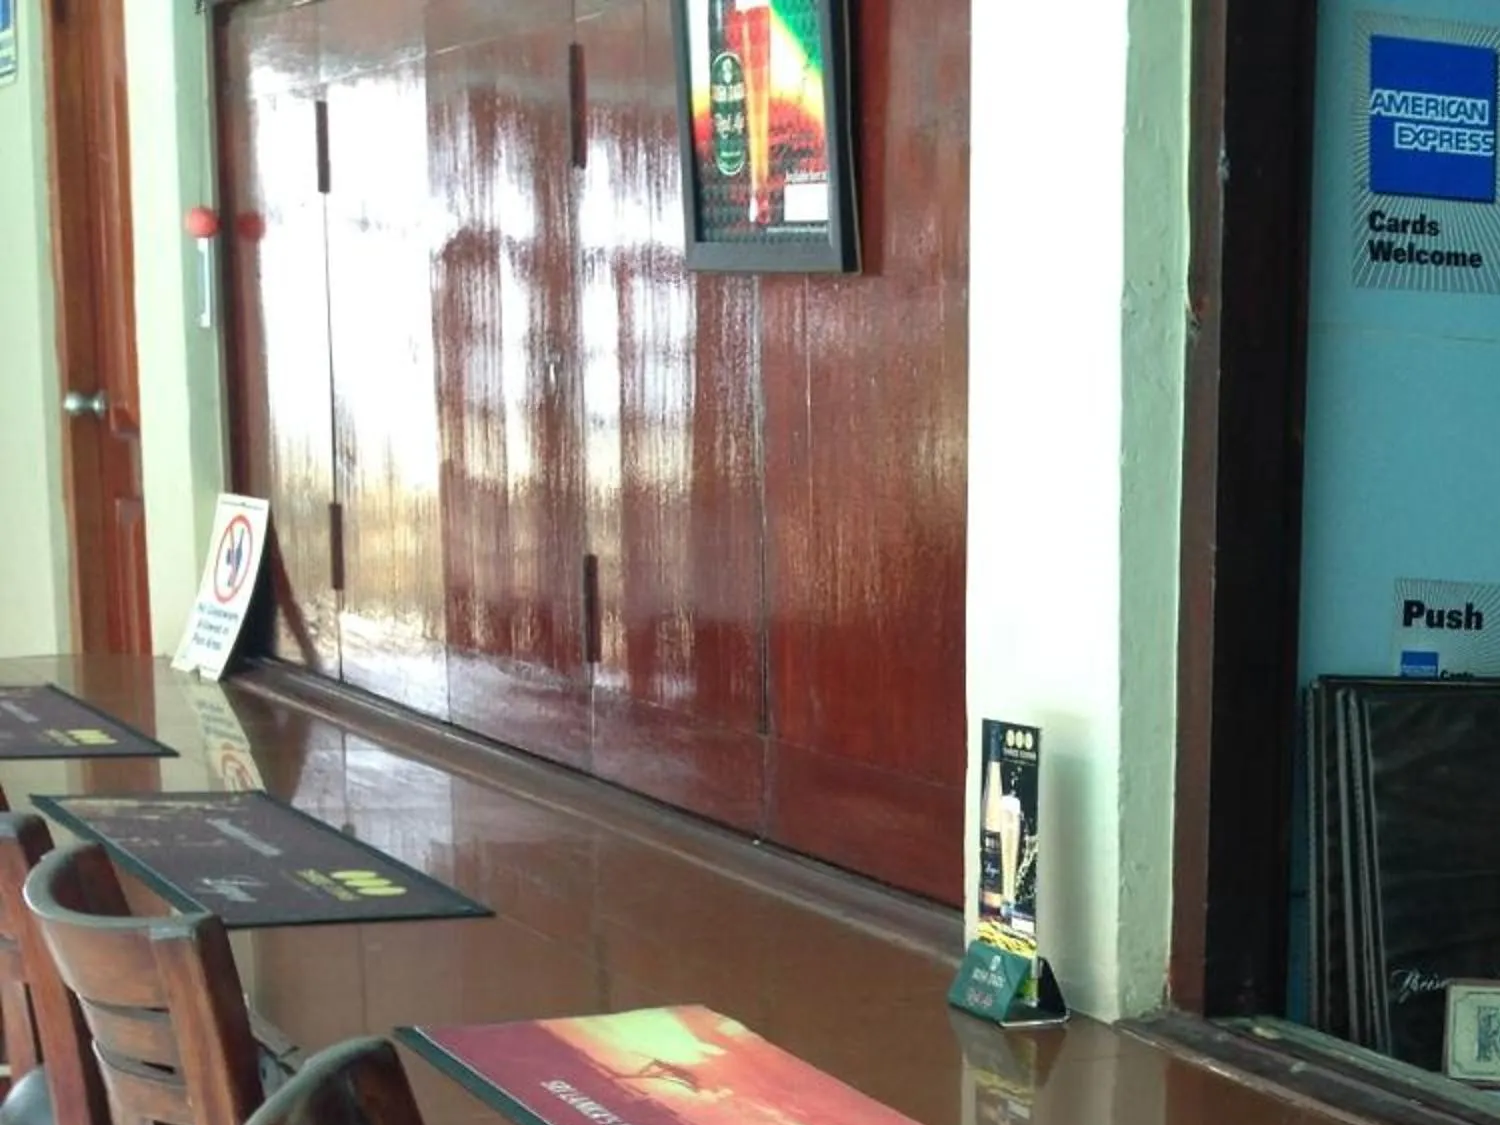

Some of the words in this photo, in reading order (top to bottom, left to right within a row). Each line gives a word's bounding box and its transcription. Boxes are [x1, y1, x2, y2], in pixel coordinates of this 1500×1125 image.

[1371, 89, 1489, 125] AMERICAN
[1394, 122, 1495, 156] EXPRESS
[1368, 210, 1441, 237] Cards
[1367, 239, 1484, 268] Welcome
[1402, 600, 1483, 631] Push
